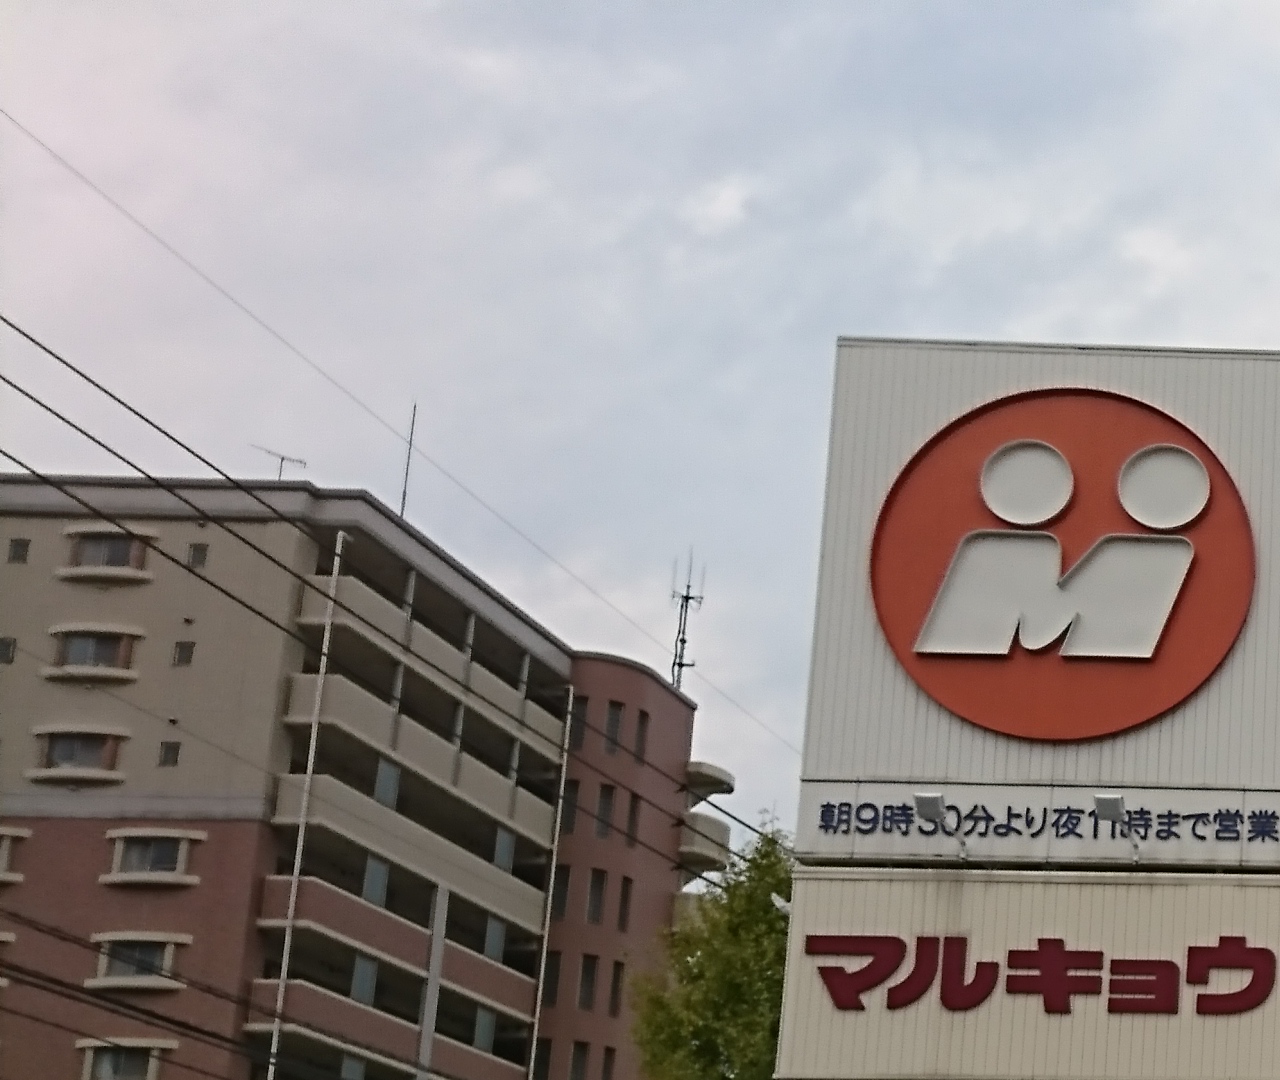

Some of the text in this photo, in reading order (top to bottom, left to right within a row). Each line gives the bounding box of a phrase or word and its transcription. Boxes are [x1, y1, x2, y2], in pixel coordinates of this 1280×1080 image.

[805, 934, 1277, 1016] マルキョウ
